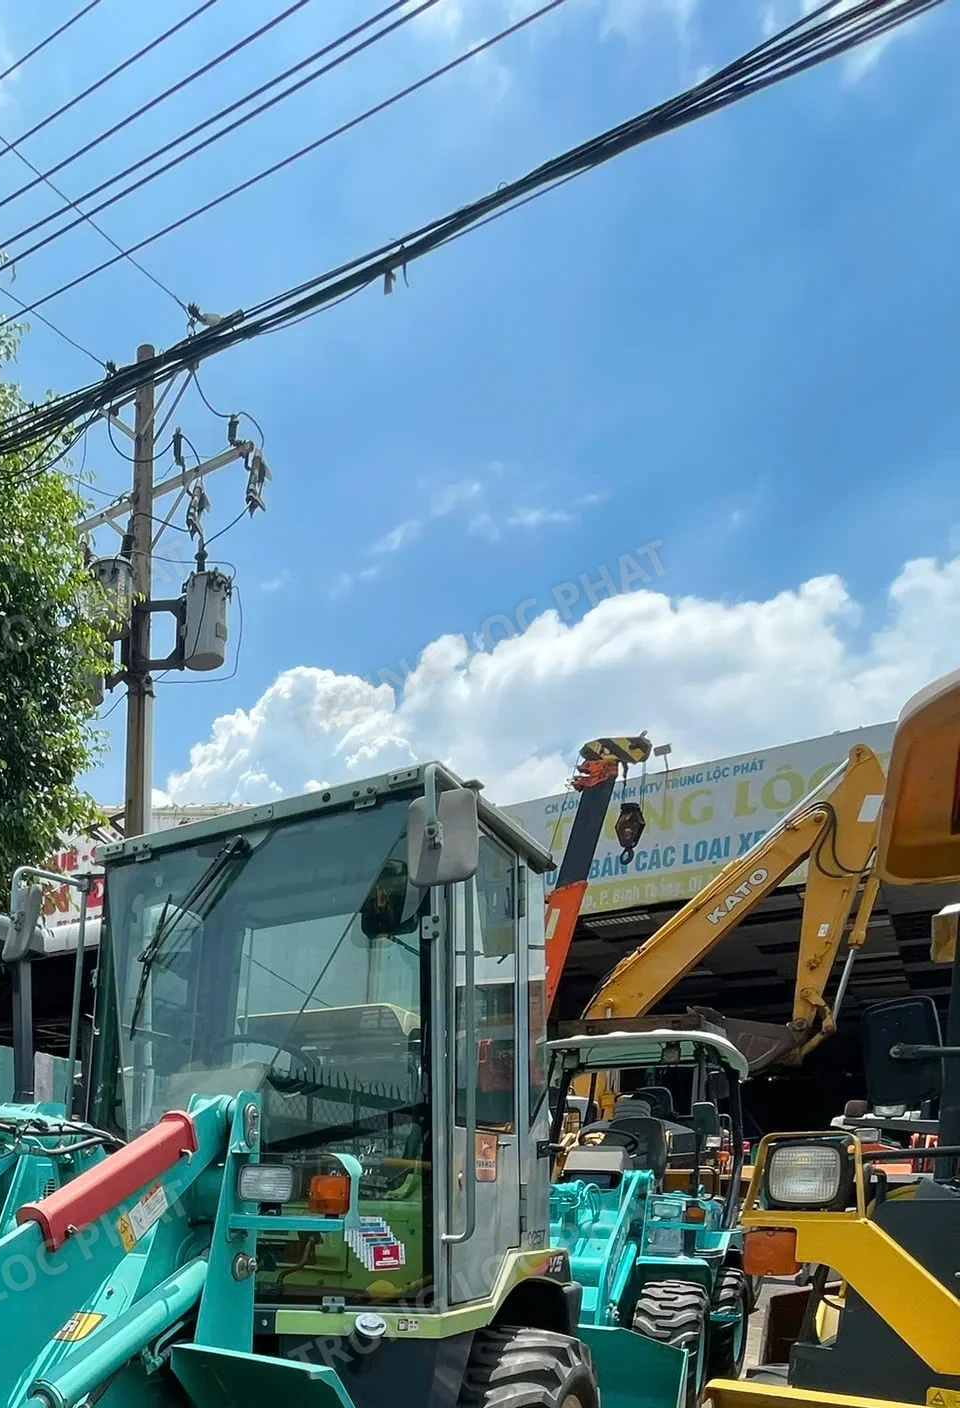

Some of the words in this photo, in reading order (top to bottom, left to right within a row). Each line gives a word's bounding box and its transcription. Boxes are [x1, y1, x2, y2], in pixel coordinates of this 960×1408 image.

[545, 804, 560, 814] CN
[561, 798, 580, 812] CÔN
[666, 772, 703, 789] TRUNG
[707, 764, 730, 784] LỘC
[733, 759, 765, 776] PHÁT
[589, 851, 628, 880] BÁN
[635, 844, 675, 873] CÁC
[682, 837, 731, 865] LOẠI
[705, 867, 769, 927] KATO
